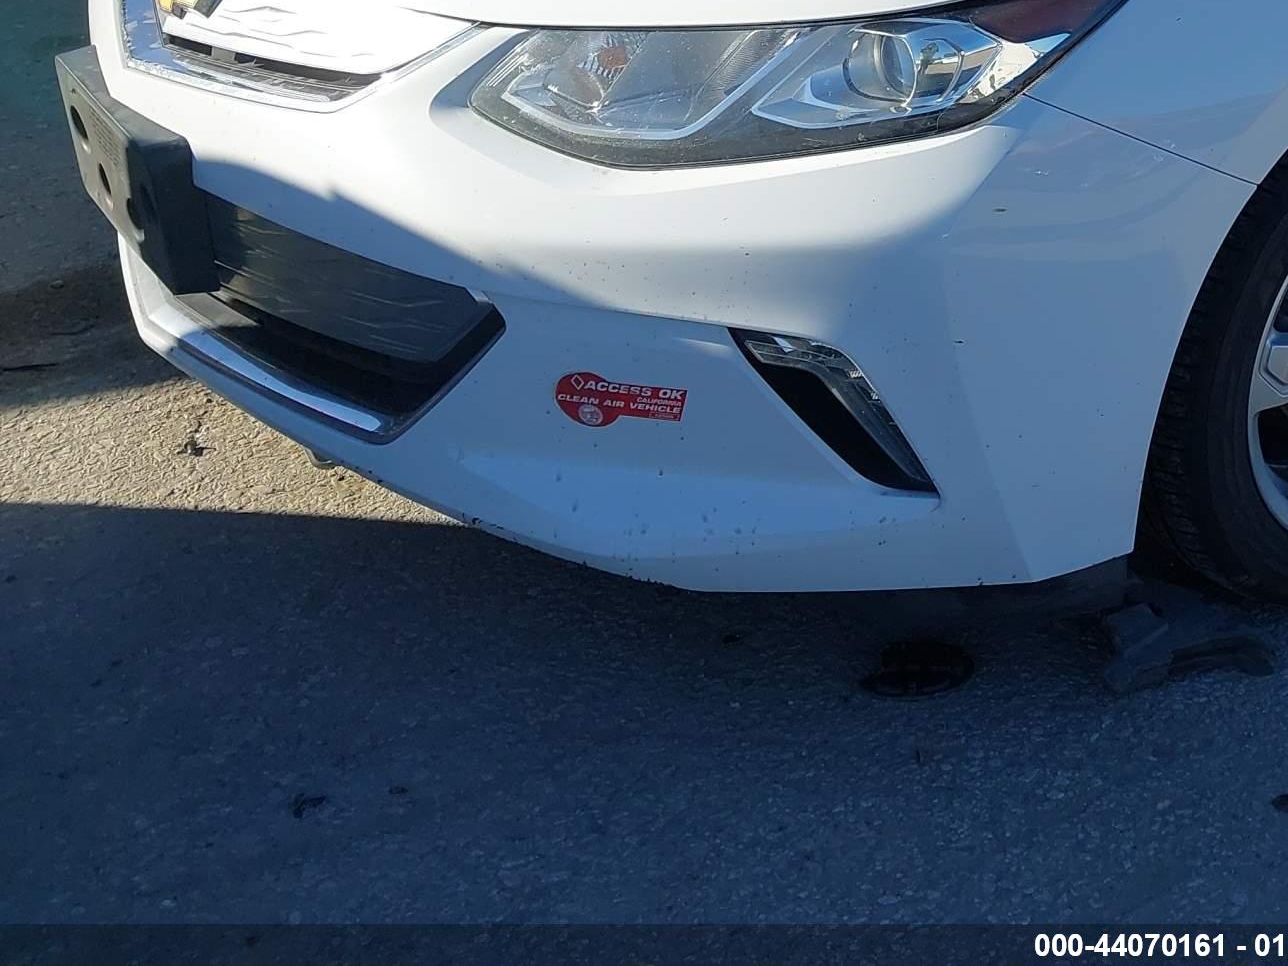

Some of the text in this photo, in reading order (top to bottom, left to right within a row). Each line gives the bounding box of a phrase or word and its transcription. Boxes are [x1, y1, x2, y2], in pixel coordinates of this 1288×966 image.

[584, 380, 686, 400] ACCESS OK
[557, 393, 682, 414] CLEAN AIR VEHICLE
